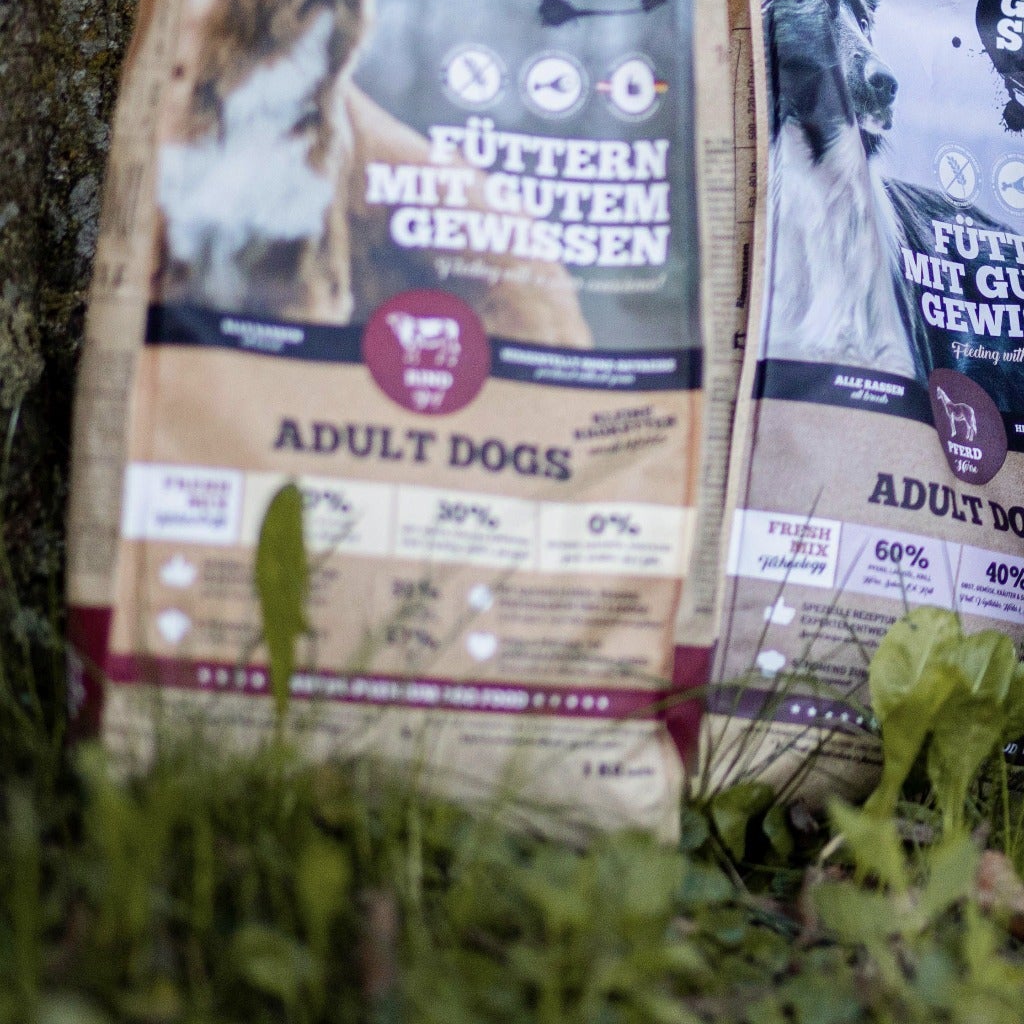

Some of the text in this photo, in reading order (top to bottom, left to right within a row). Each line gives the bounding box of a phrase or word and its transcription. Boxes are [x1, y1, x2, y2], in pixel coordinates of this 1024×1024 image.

[429, 118, 669, 182] FÜTTERN
[366, 163, 670, 224] MIT GUTEM
[390, 207, 670, 268] GEWISSEN
[901, 247, 966, 296] MIT
[952, 340, 1002, 366] Feeding
[834, 374, 905, 397] ALLE RASSEN
[273, 416, 572, 483] ADULT DOGS
[947, 440, 983, 461] PFERD
[867, 472, 984, 526] ADULT
[588, 512, 641, 536] 0%
[768, 520, 832, 541] FRESH
[790, 540, 829, 557] MIX
[875, 539, 930, 570] 60%
